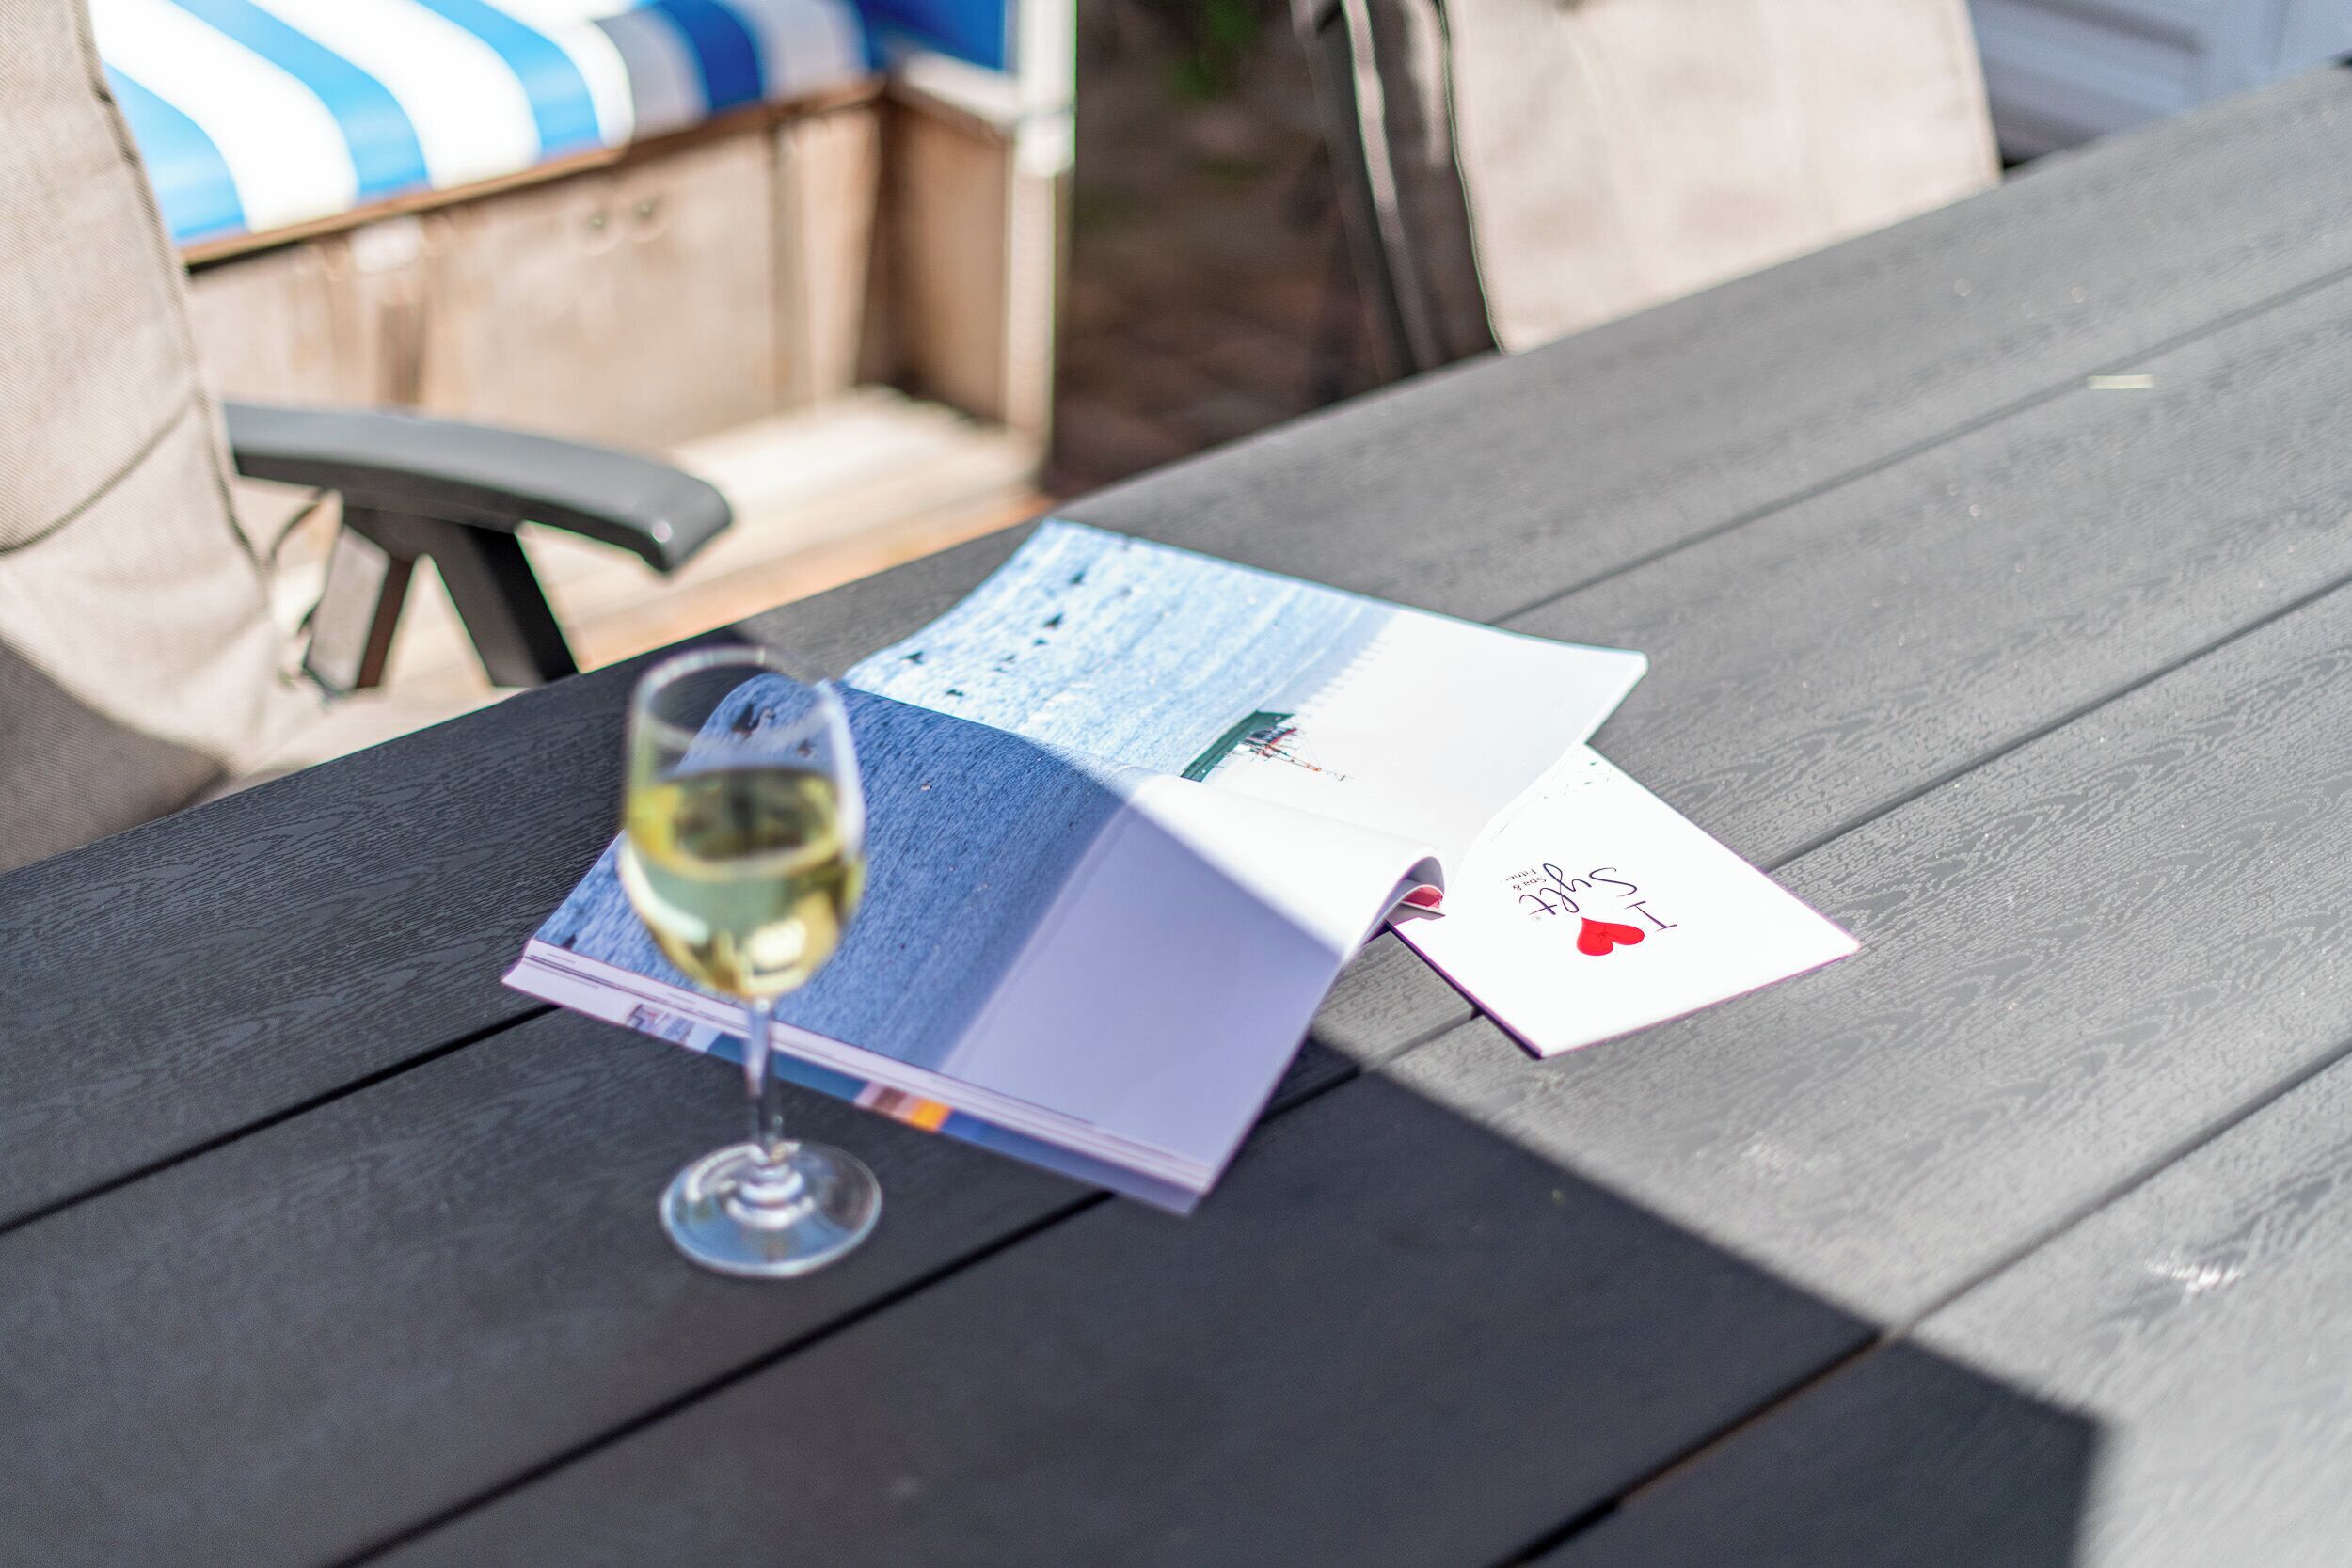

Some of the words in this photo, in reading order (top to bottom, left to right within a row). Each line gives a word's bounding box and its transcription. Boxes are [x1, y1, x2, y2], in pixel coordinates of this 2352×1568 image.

[1500, 867, 1537, 883] Fitne
[1521, 877, 1548, 888] Spa
[1518, 863, 1638, 916] Sylt
[1624, 899, 1677, 932] I
